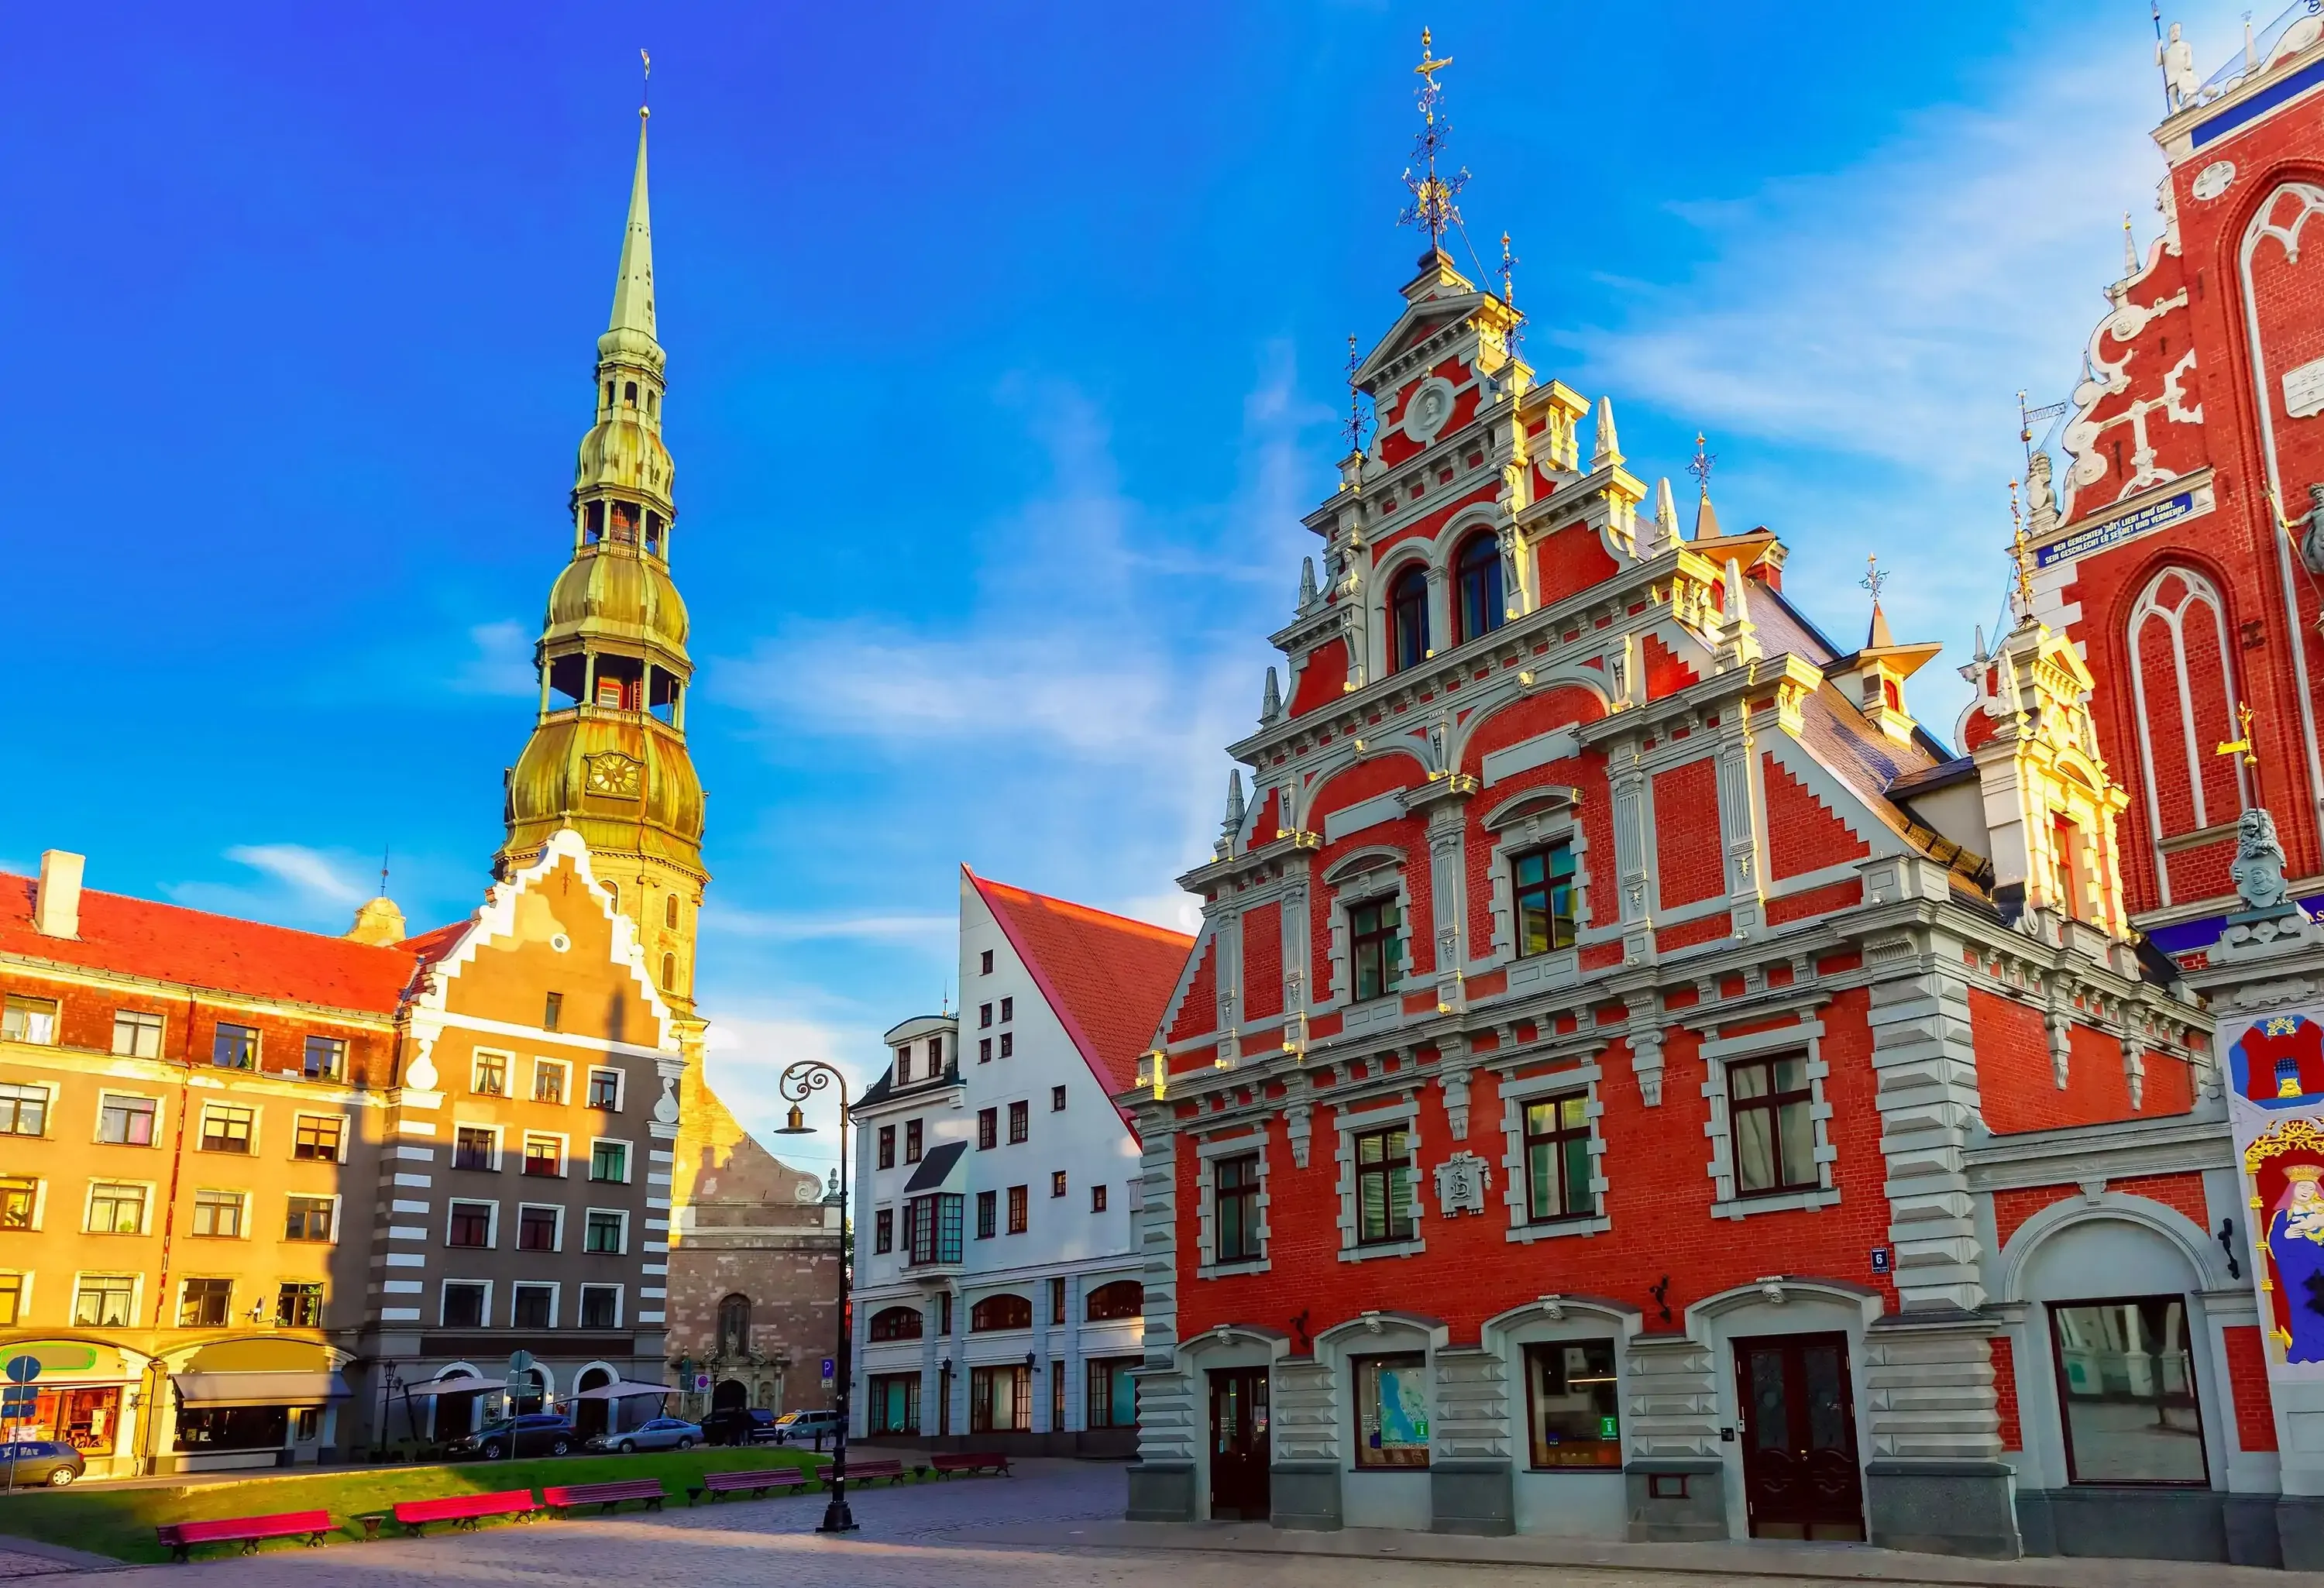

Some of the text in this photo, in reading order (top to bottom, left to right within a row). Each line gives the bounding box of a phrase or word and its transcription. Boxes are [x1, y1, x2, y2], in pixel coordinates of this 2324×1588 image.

[2060, 538, 2099, 559] GESCHLECHT
[2135, 518, 2150, 530] UND
[2150, 504, 2186, 524] VERMEHRT
[2067, 528, 2103, 547] GERECHTEN
[2121, 513, 2140, 527] LIEBT
[2140, 506, 2155, 519] UND
[1875, 1254, 1883, 1264] 6
[824, 1361, 830, 1376] P
